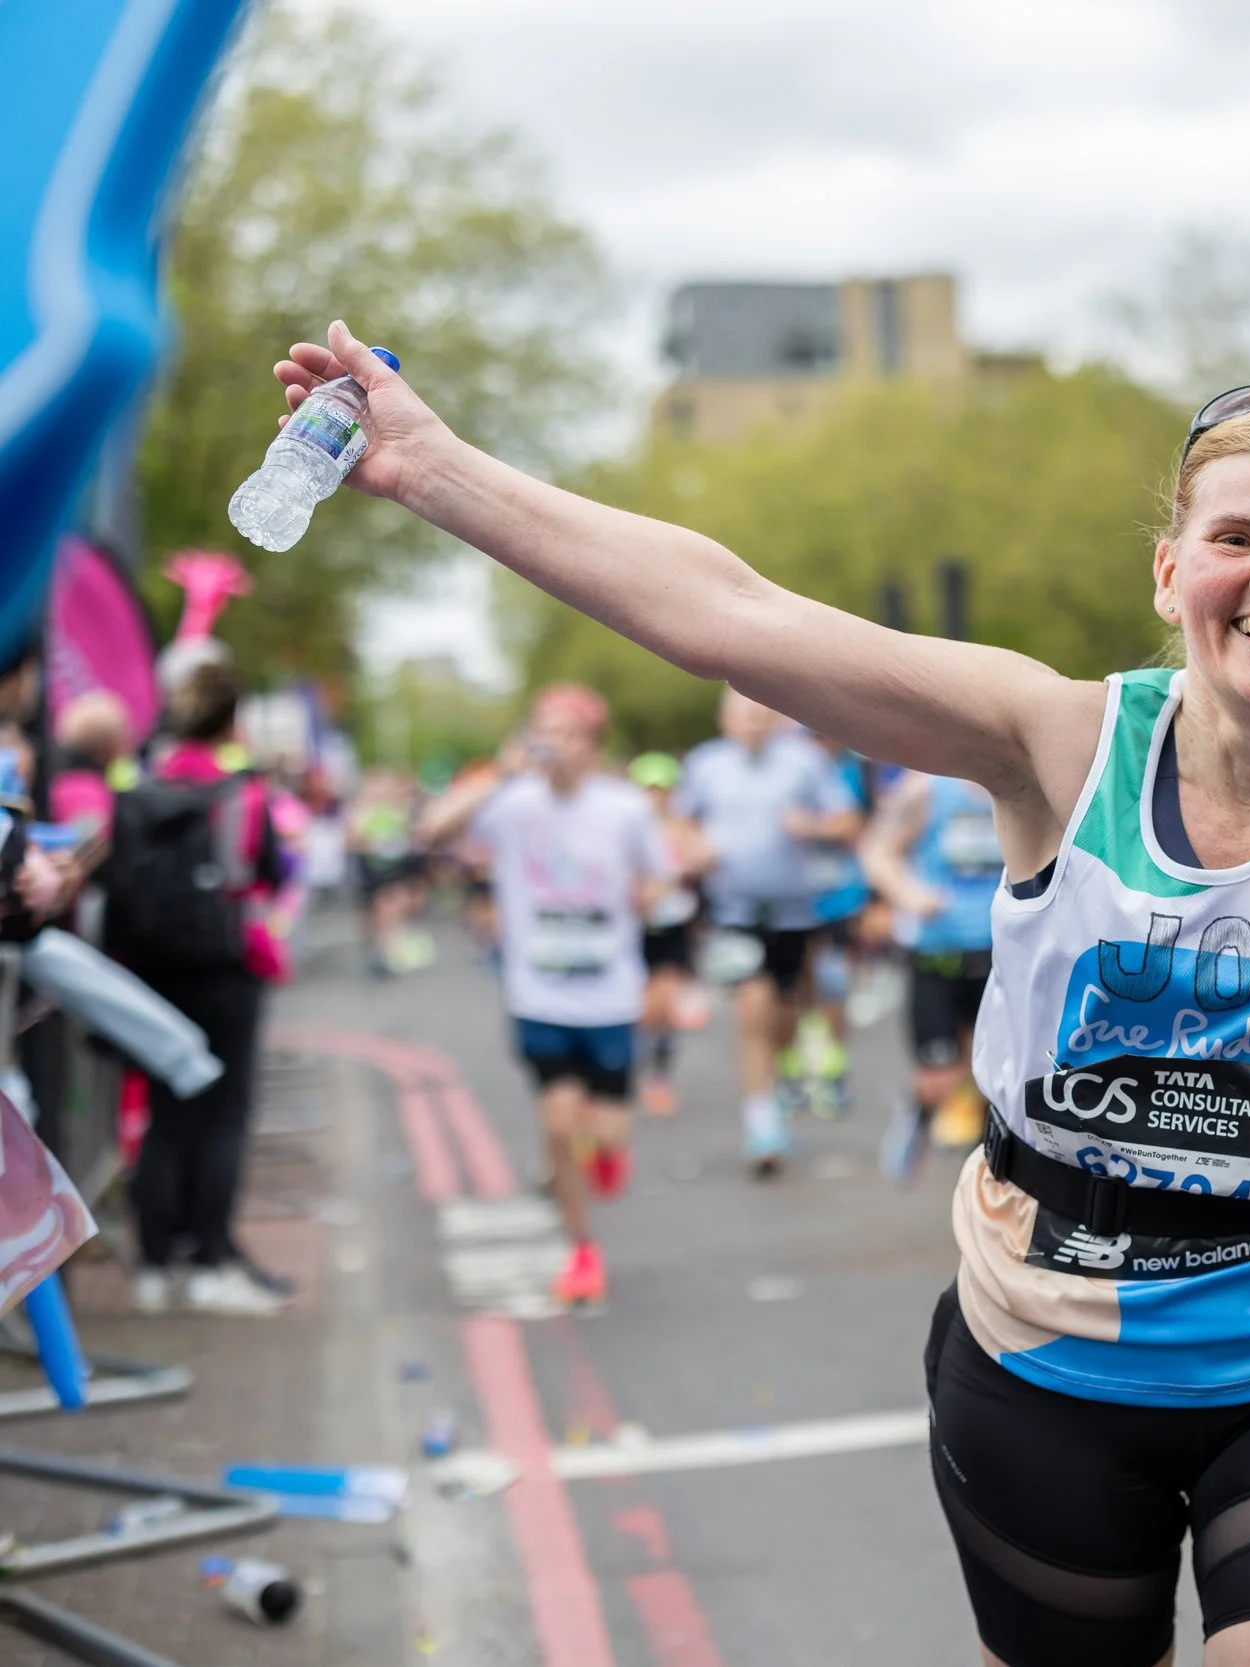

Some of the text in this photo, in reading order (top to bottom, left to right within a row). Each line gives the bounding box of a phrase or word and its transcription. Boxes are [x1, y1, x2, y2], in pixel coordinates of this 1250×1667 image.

[1068, 984, 1165, 1053] Sue
[1154, 1071, 1215, 1090] TATA
[1147, 1110, 1239, 1138] SERVICES
[1120, 1147, 1188, 1163] #WeRunTogether
[1133, 1255, 1181, 1272] new
